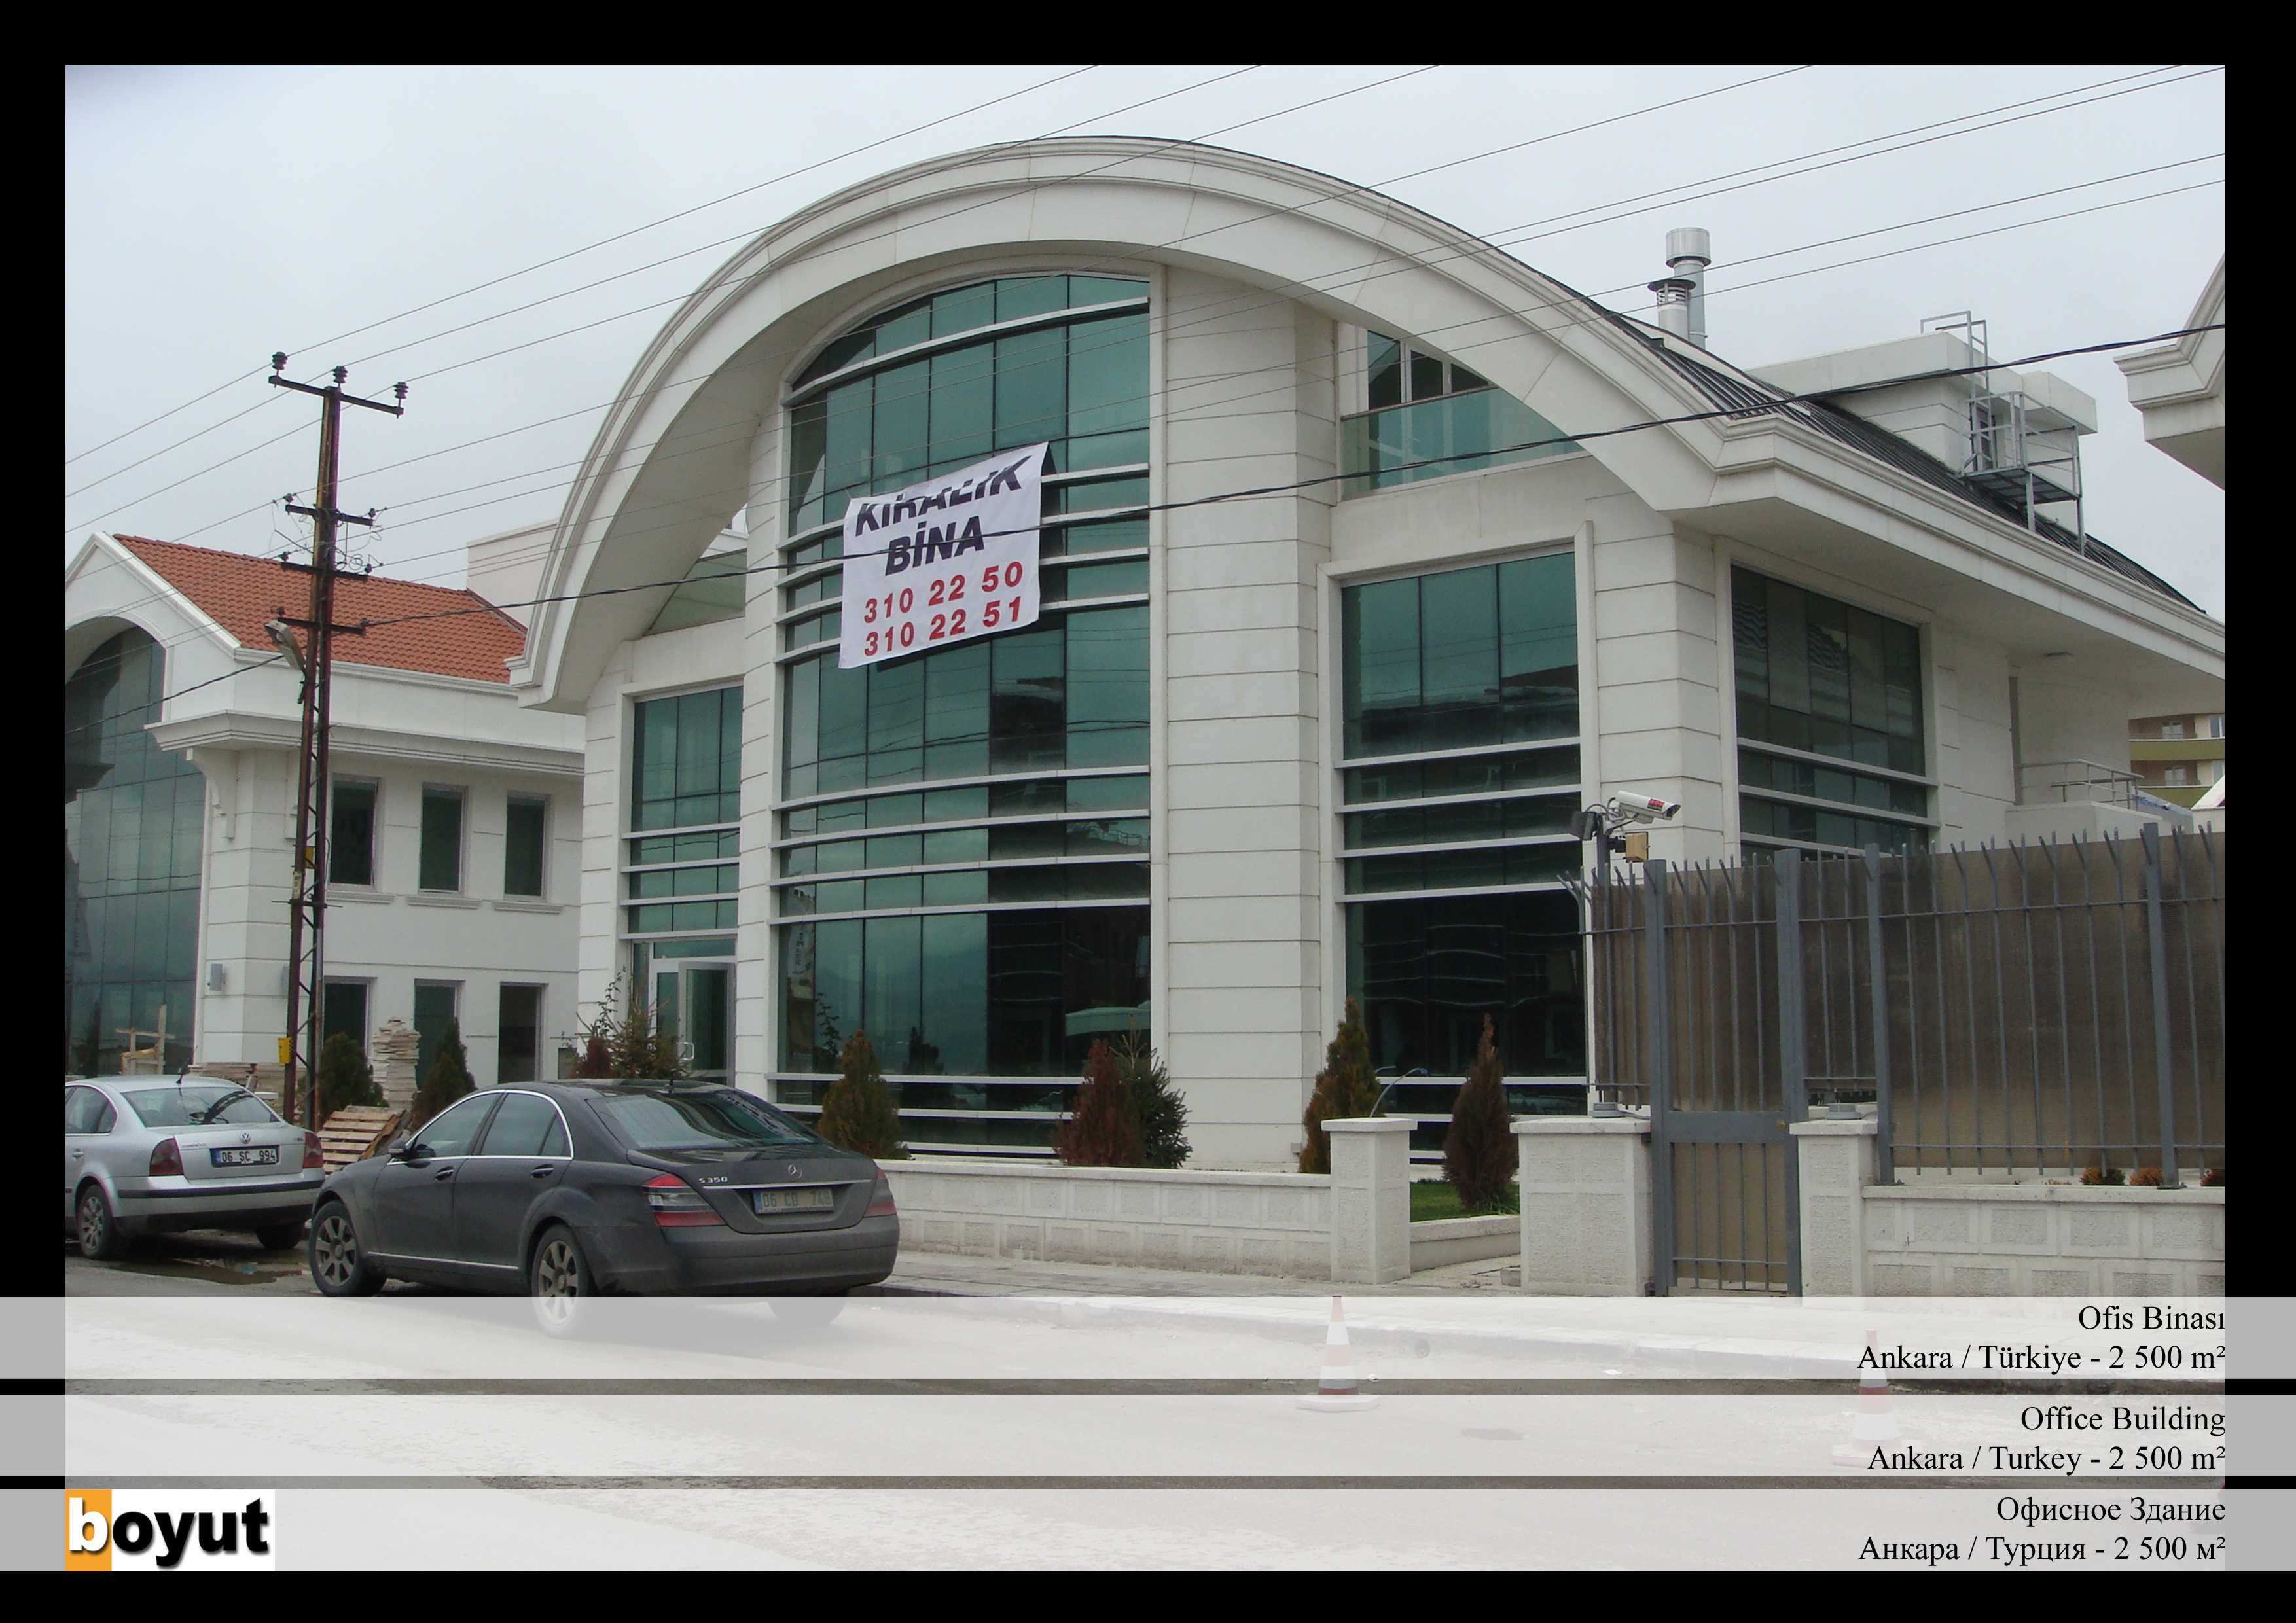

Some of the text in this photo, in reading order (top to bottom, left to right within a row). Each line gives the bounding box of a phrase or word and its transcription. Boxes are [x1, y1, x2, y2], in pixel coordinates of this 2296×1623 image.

[885, 516, 984, 576] BİNA
[864, 562, 1023, 624] 310 22 50
[864, 596, 1021, 656] 310 22 51
[222, 1150, 275, 1162] 06 SC 994
